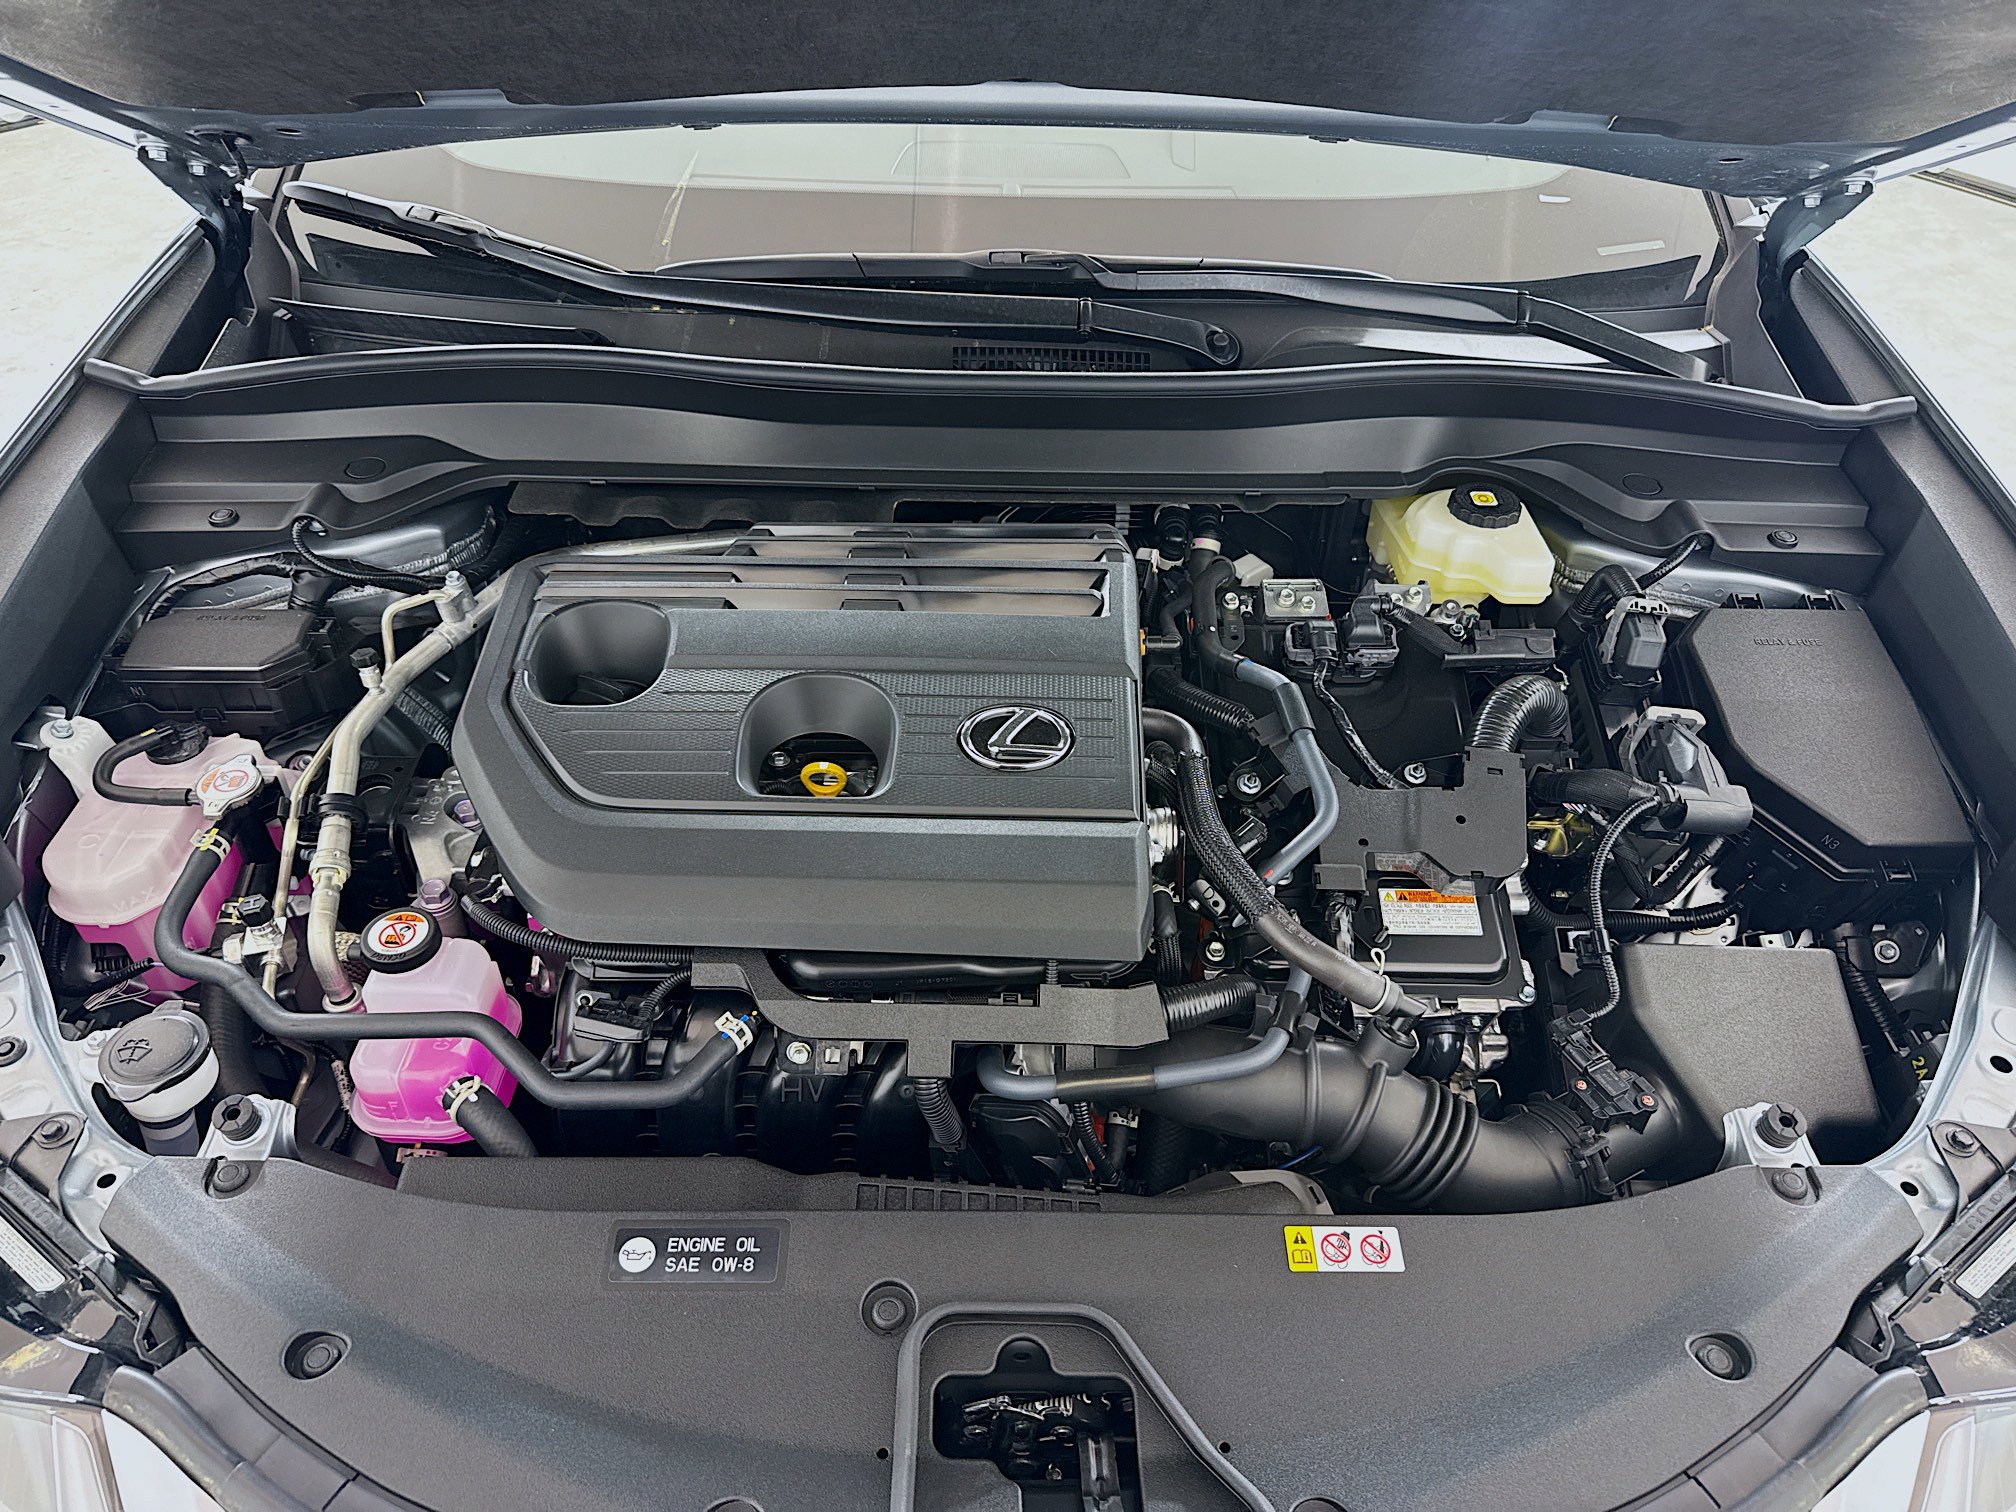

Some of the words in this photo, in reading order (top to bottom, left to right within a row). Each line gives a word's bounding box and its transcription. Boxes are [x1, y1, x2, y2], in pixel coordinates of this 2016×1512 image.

[1753, 638, 1784, 646] RELAY
[1796, 638, 1822, 646] FUSE
[1821, 834, 1840, 850] N3
[1911, 1056, 1929, 1080] 2A
[781, 1077, 827, 1103] HV
[667, 1237, 726, 1253] ENGINE
[736, 1237, 761, 1253] OIL
[664, 1257, 701, 1273] SAE
[711, 1257, 755, 1273] 0W-8
